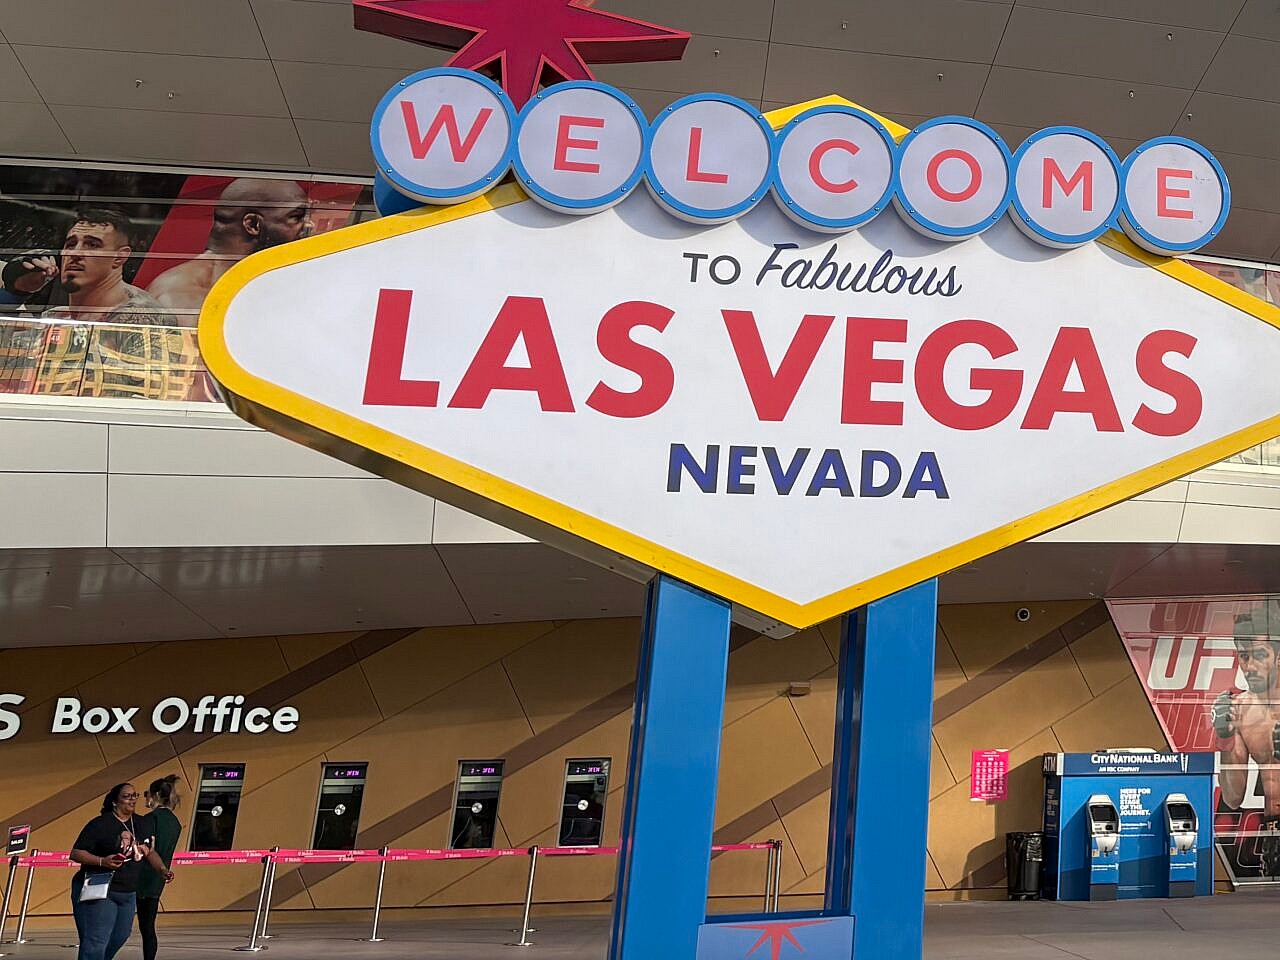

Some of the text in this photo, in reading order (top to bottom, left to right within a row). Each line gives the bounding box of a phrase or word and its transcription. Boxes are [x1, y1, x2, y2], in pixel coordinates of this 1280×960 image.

[398, 100, 1195, 221] WELCOME
[682, 242, 962, 299] TO Fabulous
[363, 288, 1203, 437] LAS VEGAS
[667, 443, 950, 500] NEVADA
[1147, 636, 1250, 690] UF
[52, 697, 139, 733] Box
[152, 695, 299, 734] Office
[1043, 756, 1056, 772] ATM
[1091, 754, 1178, 764] CITY NATIONAL BANK
